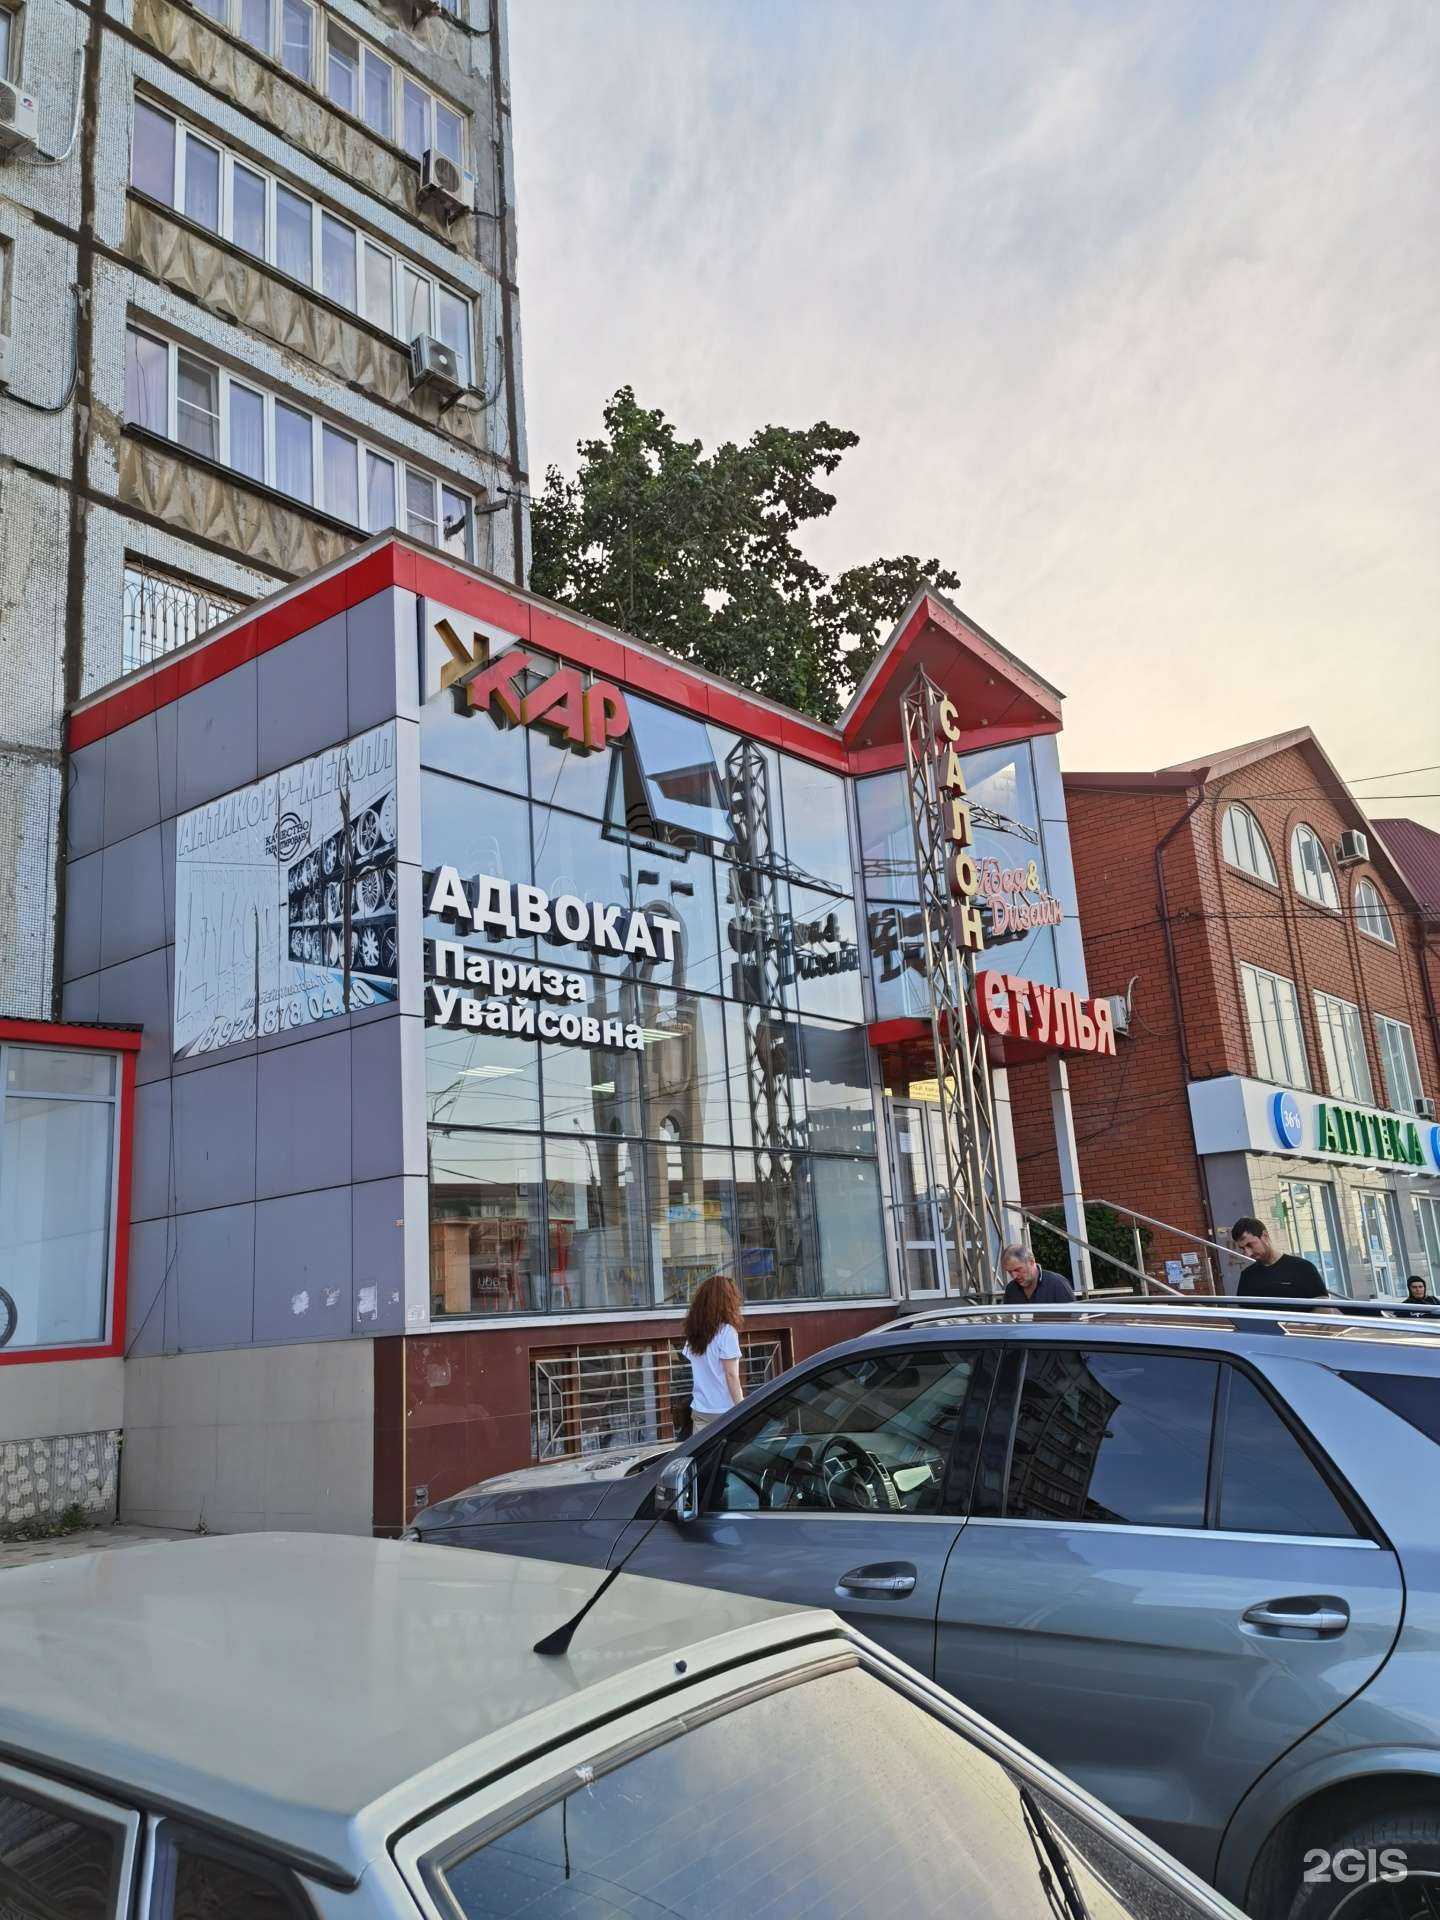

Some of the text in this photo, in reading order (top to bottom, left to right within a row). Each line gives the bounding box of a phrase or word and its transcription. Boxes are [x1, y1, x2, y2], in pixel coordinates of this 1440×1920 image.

[938, 699, 984, 951] САЛОН
[430, 865, 681, 962] АДВОКАТ
[434, 939, 587, 1001] Париза
[984, 969, 1117, 1056] СТУЛЬЯ
[1318, 1103, 1427, 1166] АПТЕКА
